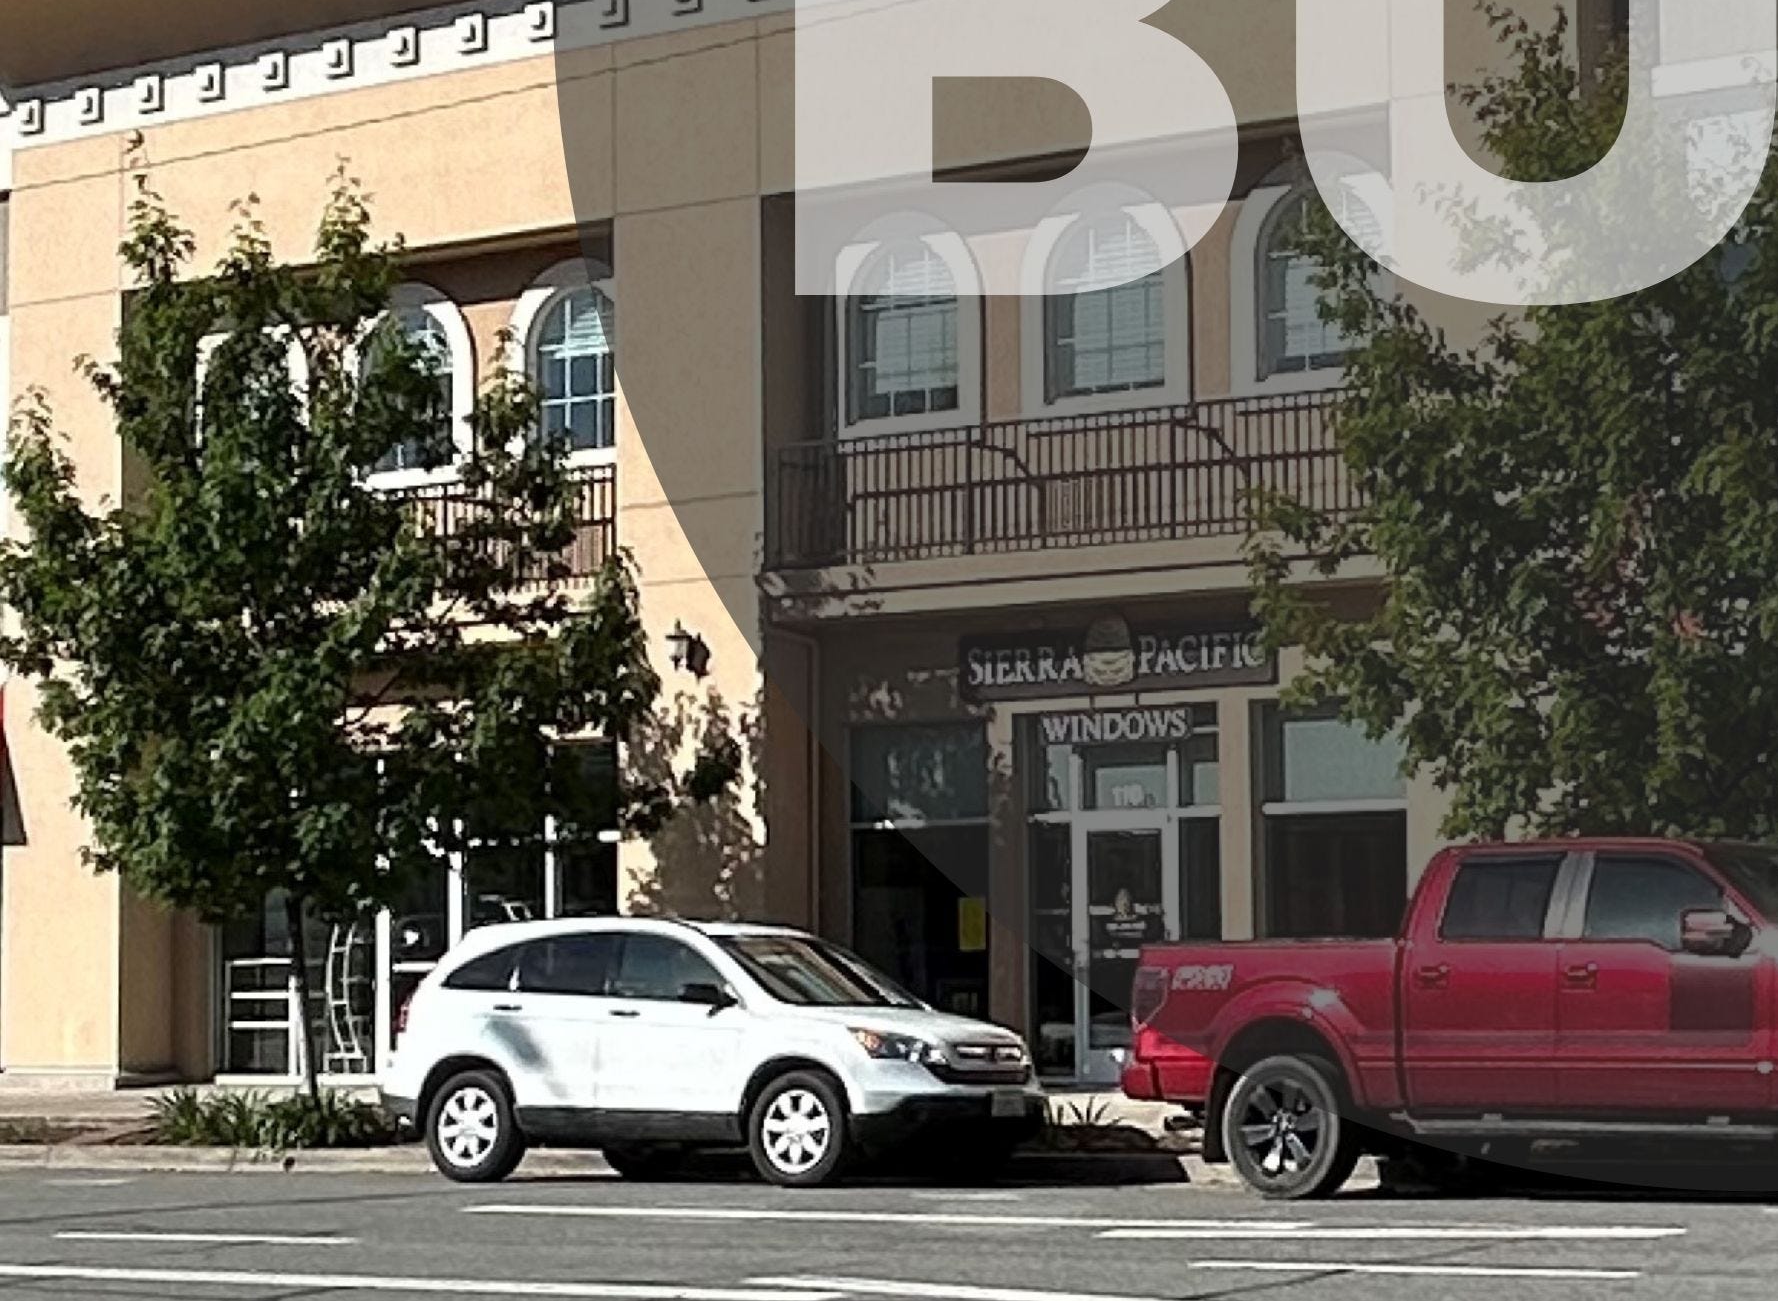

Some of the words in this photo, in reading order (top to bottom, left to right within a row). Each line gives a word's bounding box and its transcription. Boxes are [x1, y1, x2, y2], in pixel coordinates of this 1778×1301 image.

[967, 643, 1084, 685] SIERRA
[1138, 632, 1266, 674] PACIFIC
[1042, 709, 1187, 742] WINDOWS
